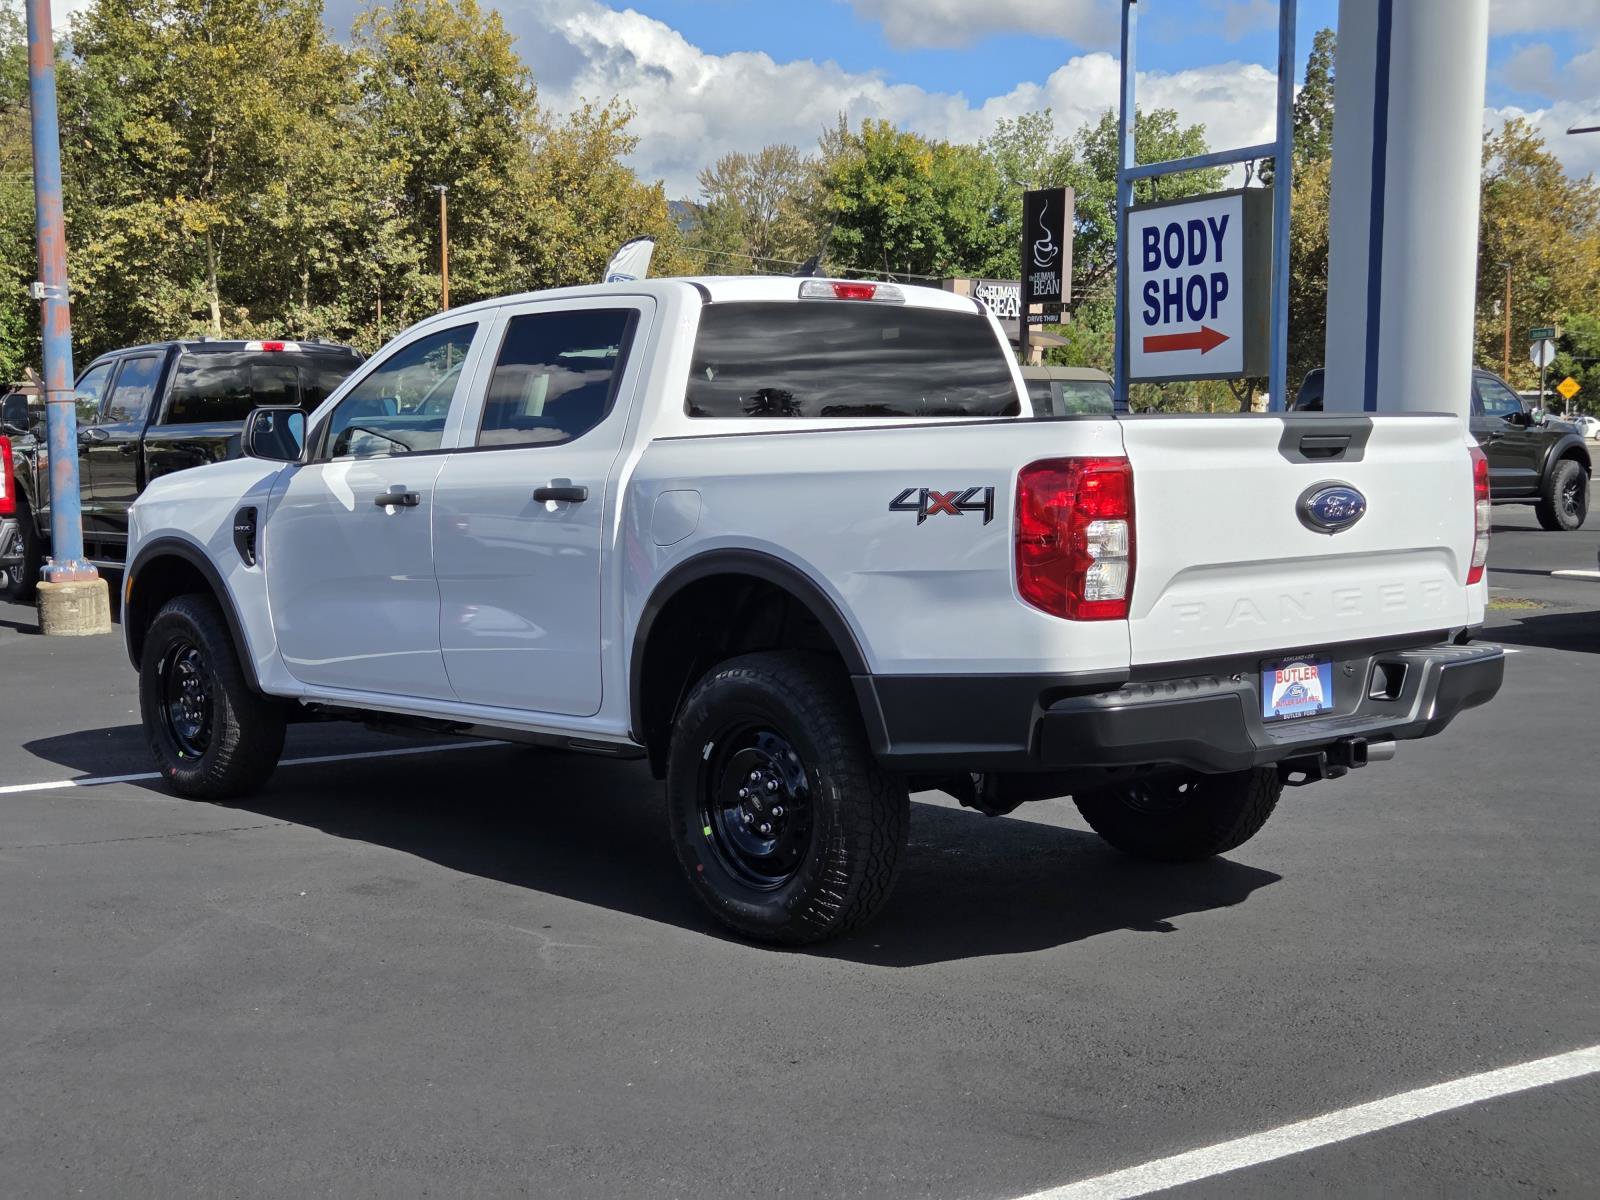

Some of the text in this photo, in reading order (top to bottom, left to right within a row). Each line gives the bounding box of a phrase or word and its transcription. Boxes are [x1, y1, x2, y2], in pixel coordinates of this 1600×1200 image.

[1142, 214, 1230, 272] BODY
[1034, 271, 1055, 281] HUMAN
[987, 285, 1020, 299] HUMAN
[1033, 279, 1060, 295] BEAN
[1142, 272, 1229, 326] SHOP
[1043, 314, 1059, 322] THRU
[1172, 578, 1450, 635] RANGER
[1276, 666, 1318, 684] BUTLER
